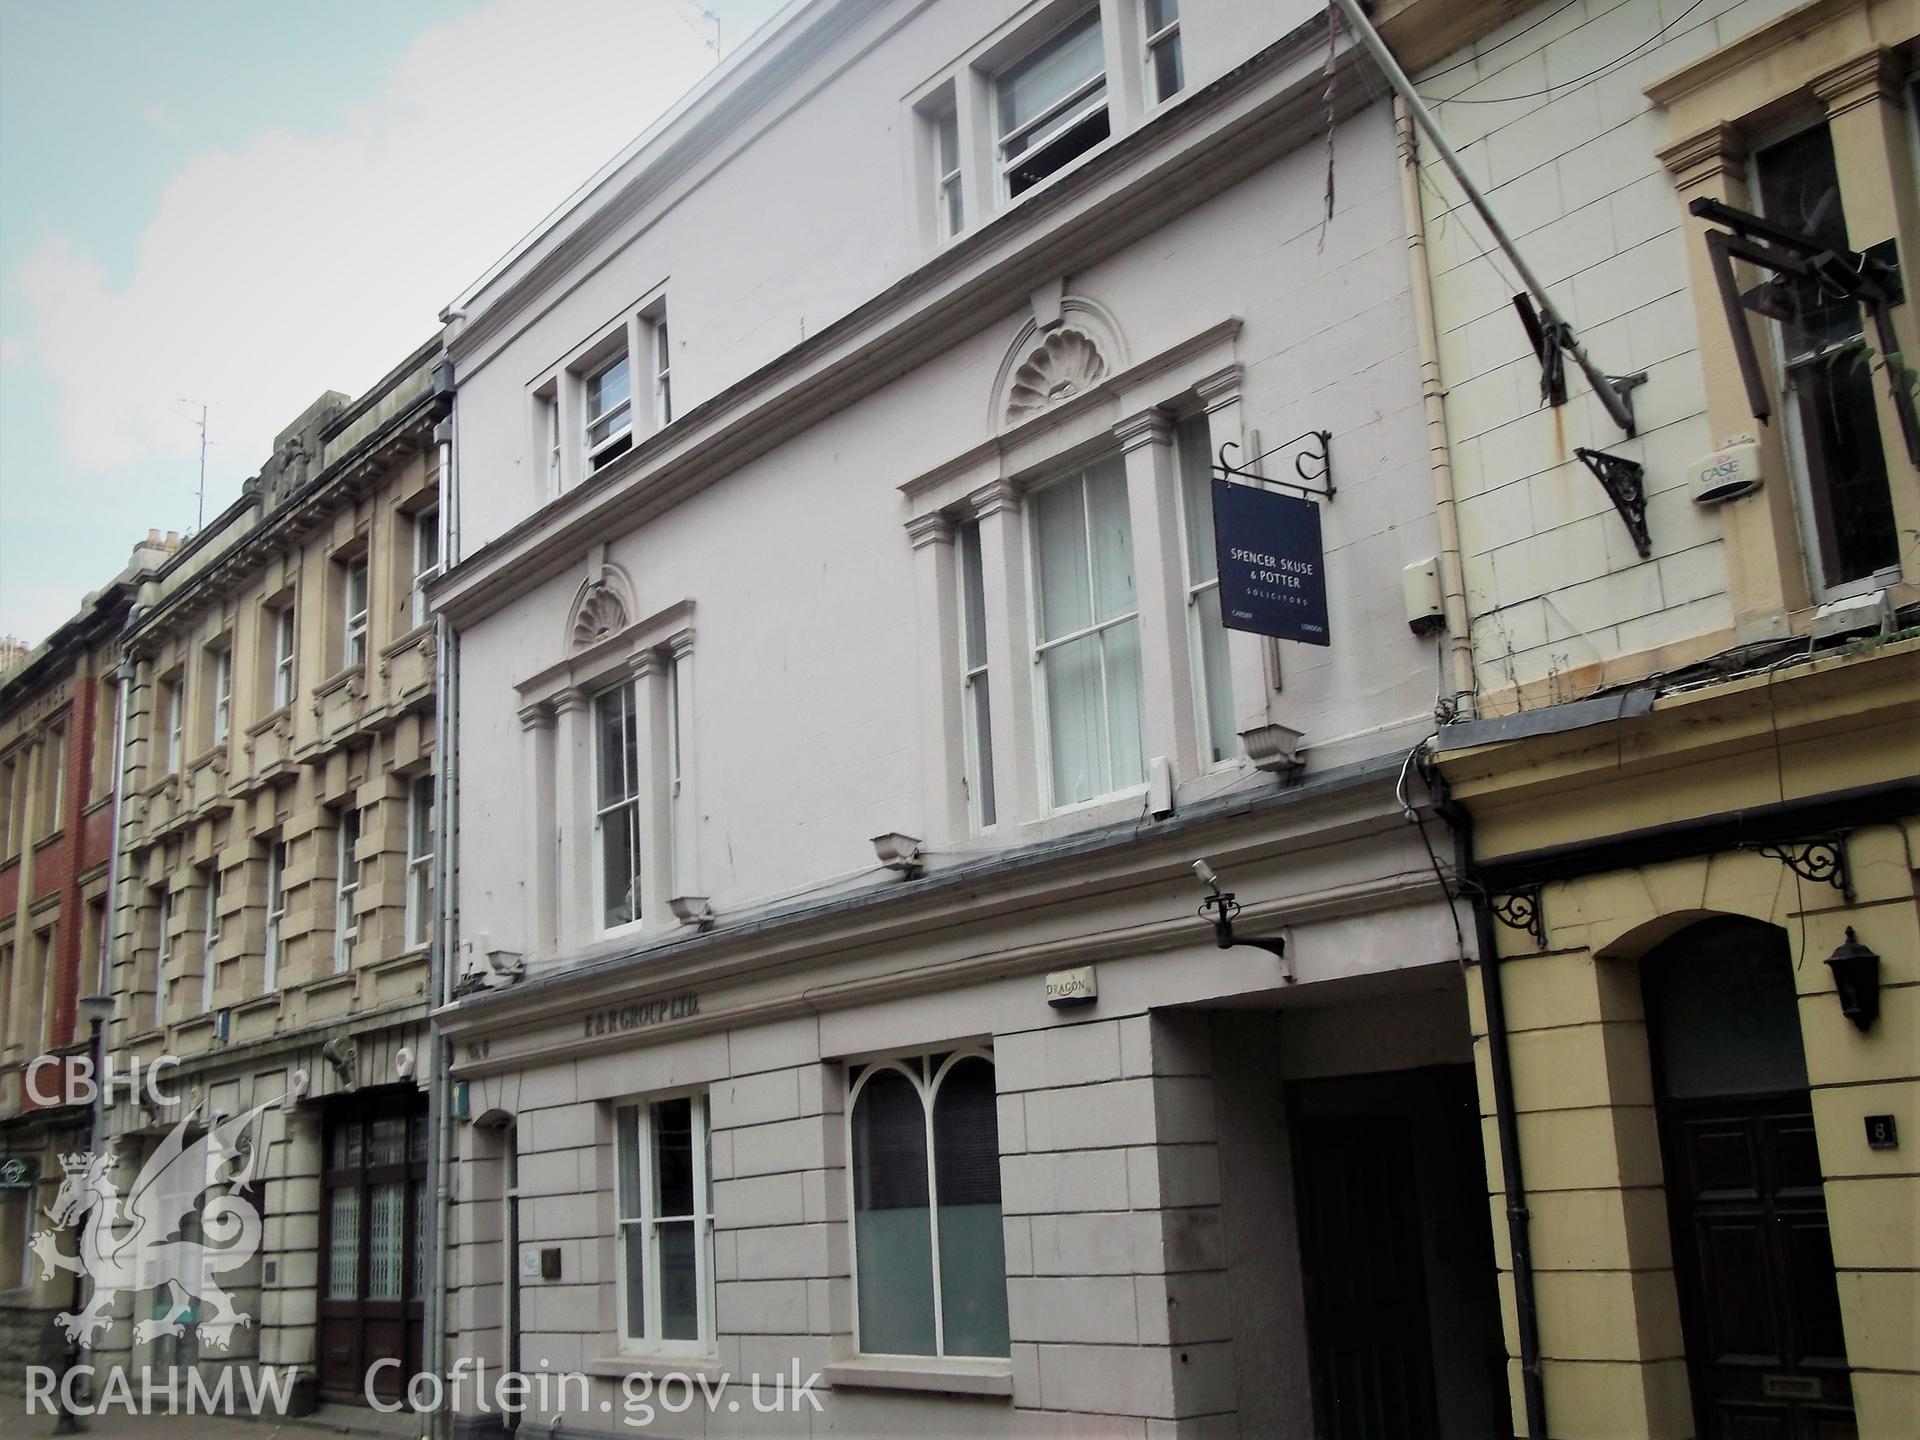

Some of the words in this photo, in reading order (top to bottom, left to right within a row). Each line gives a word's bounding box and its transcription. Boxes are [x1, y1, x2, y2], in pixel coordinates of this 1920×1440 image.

[1701, 460, 1740, 482] CASE
[1231, 548, 1276, 568] SPENCER
[1280, 558, 1313, 576] SKUSE
[1250, 570, 1257, 580] &
[1260, 570, 1301, 588] POTTER
[1247, 587, 1308, 606] SOLICITORS
[1046, 980, 1085, 995] DRAGON
[621, 1000, 668, 1030] GROUP
[1875, 1122, 1886, 1139] 8
